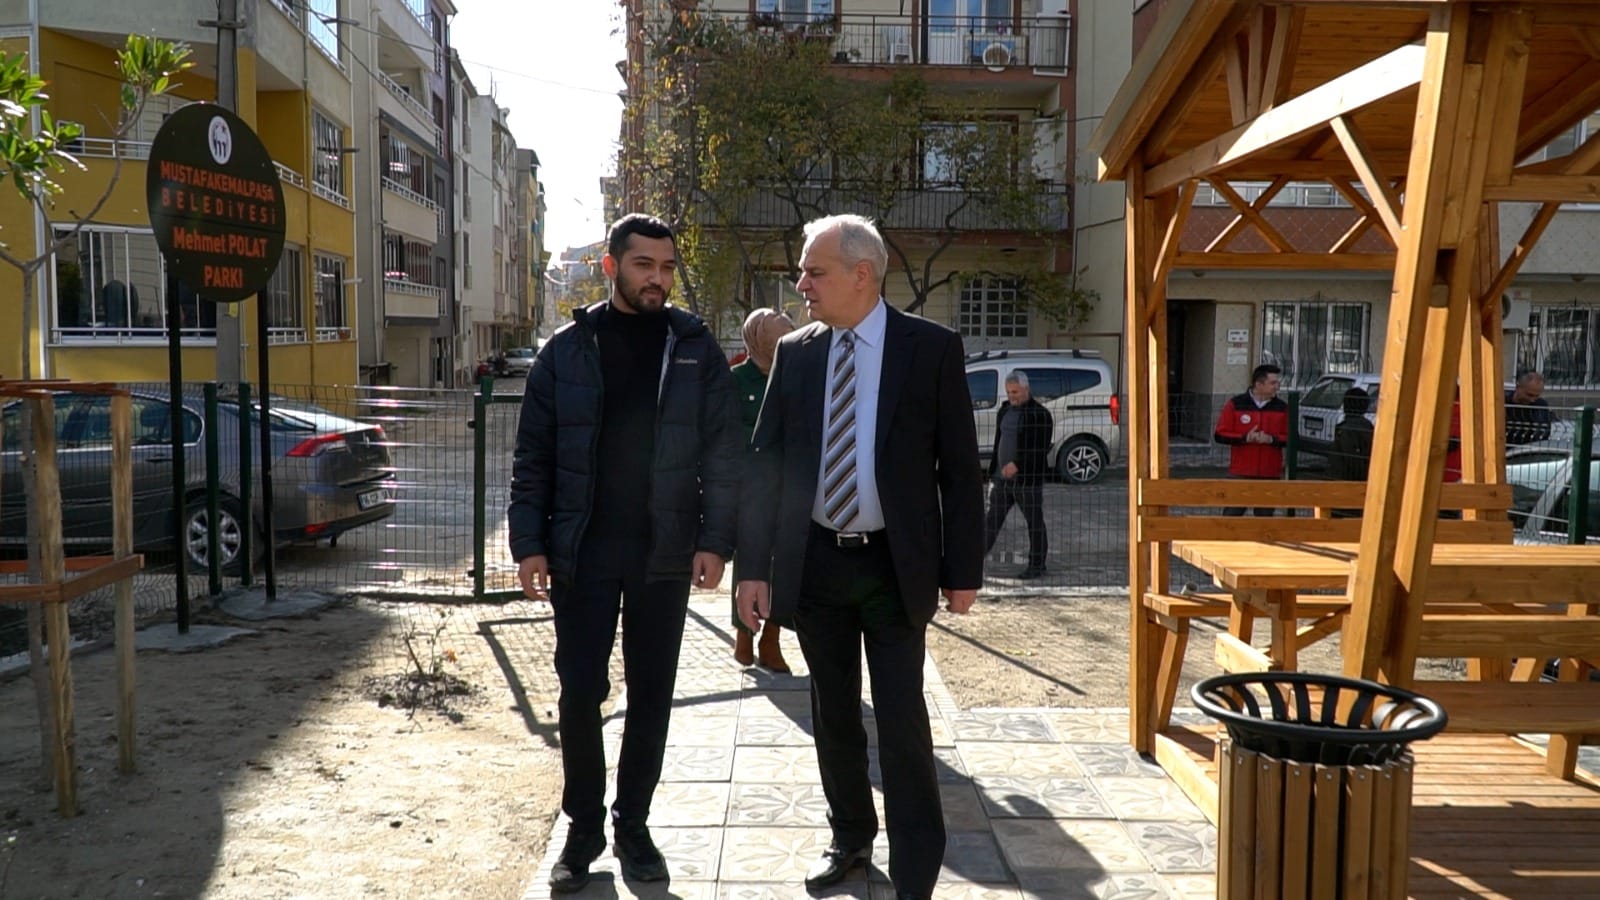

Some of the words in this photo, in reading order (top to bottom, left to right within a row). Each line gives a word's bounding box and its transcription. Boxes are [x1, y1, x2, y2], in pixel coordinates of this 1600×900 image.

[173, 226, 226, 253] Mehmet
[229, 233, 268, 258] POLAT
[204, 265, 244, 288] PARKI
